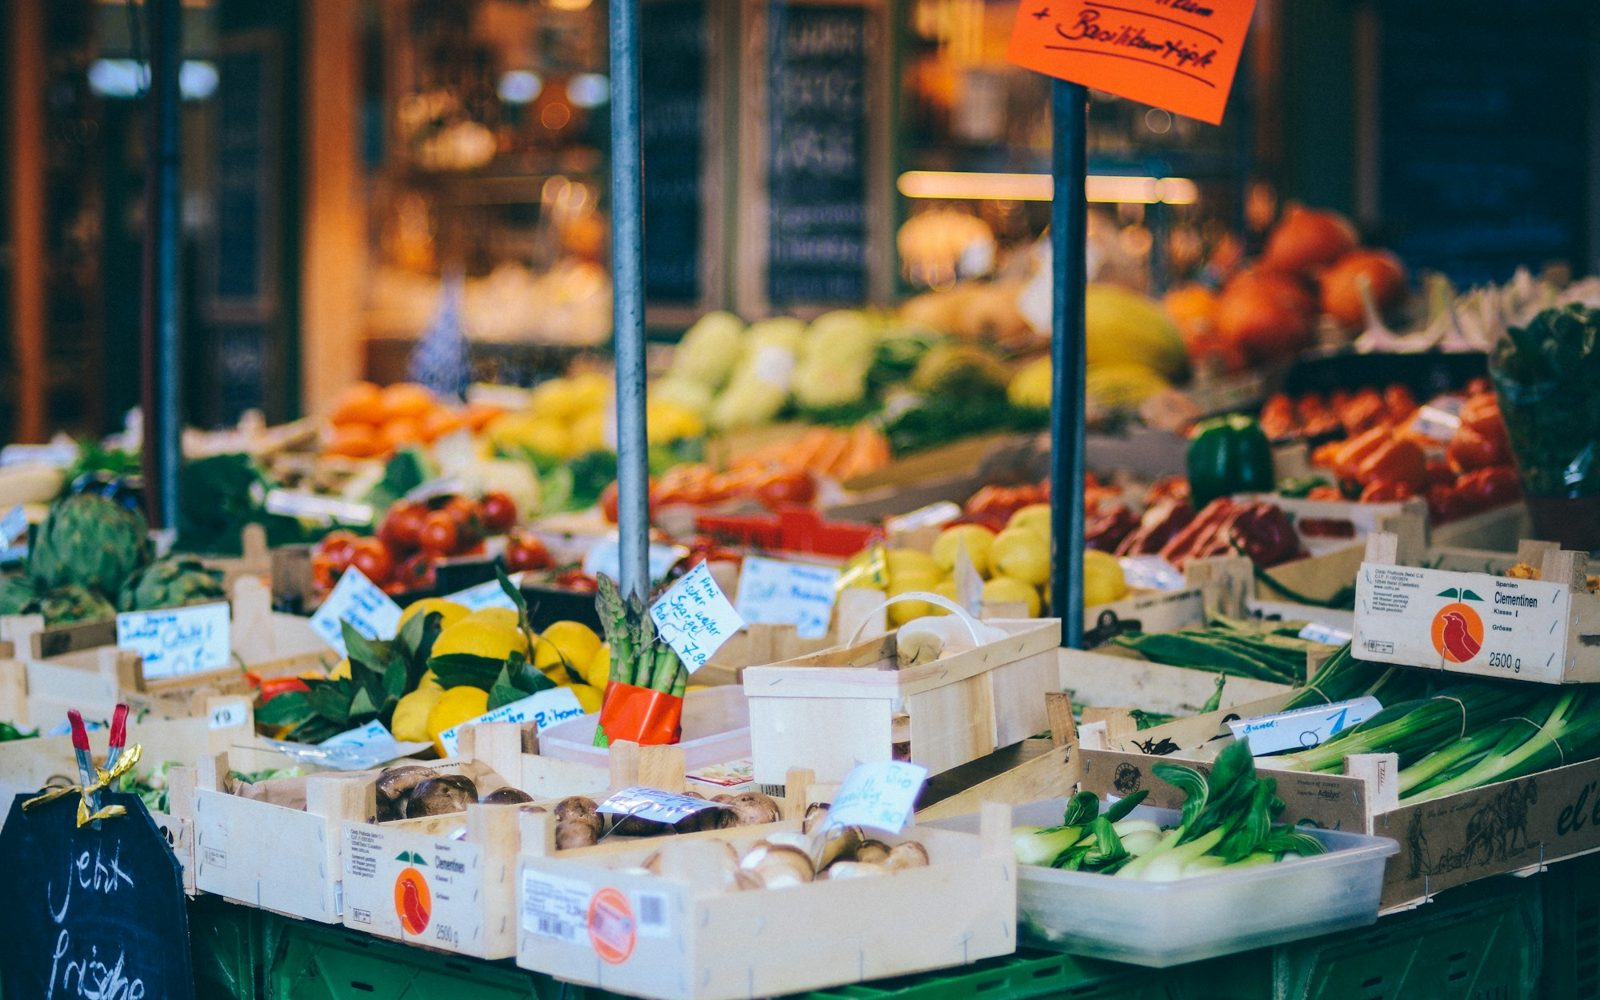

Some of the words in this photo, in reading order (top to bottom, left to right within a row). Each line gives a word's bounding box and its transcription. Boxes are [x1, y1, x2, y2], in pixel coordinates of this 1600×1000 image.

[1495, 580, 1519, 589] Spanien
[1494, 590, 1538, 609] Clementinen
[1493, 608, 1513, 616] Klasse
[1489, 651, 1513, 669] 2500
[1514, 657, 1521, 673] g
[436, 923, 453, 943] 2500
